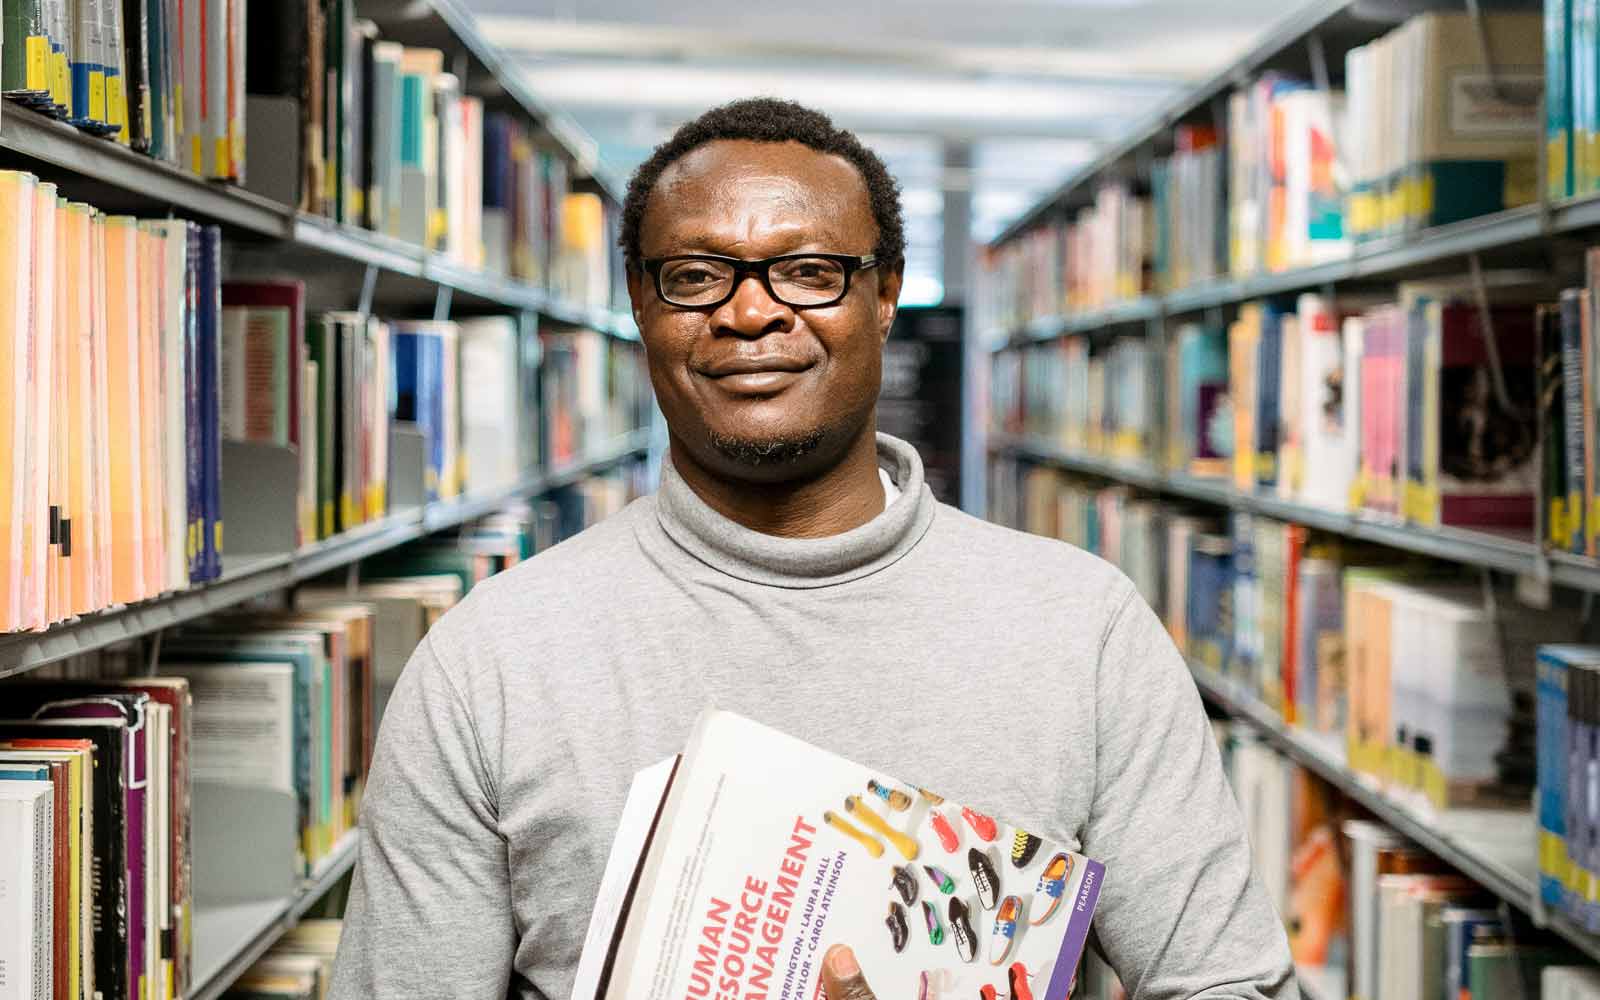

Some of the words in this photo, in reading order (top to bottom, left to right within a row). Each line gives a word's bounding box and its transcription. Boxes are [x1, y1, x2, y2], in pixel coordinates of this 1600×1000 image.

[780, 937, 804, 1000] RRINGTON
[801, 889, 819, 927] LAURA
[814, 857, 830, 885] HALL
[808, 914, 826, 951] CAROL
[821, 851, 847, 911] ATKINSON
[1077, 871, 1095, 911] PEARSON
[685, 896, 731, 1000] UMAN
